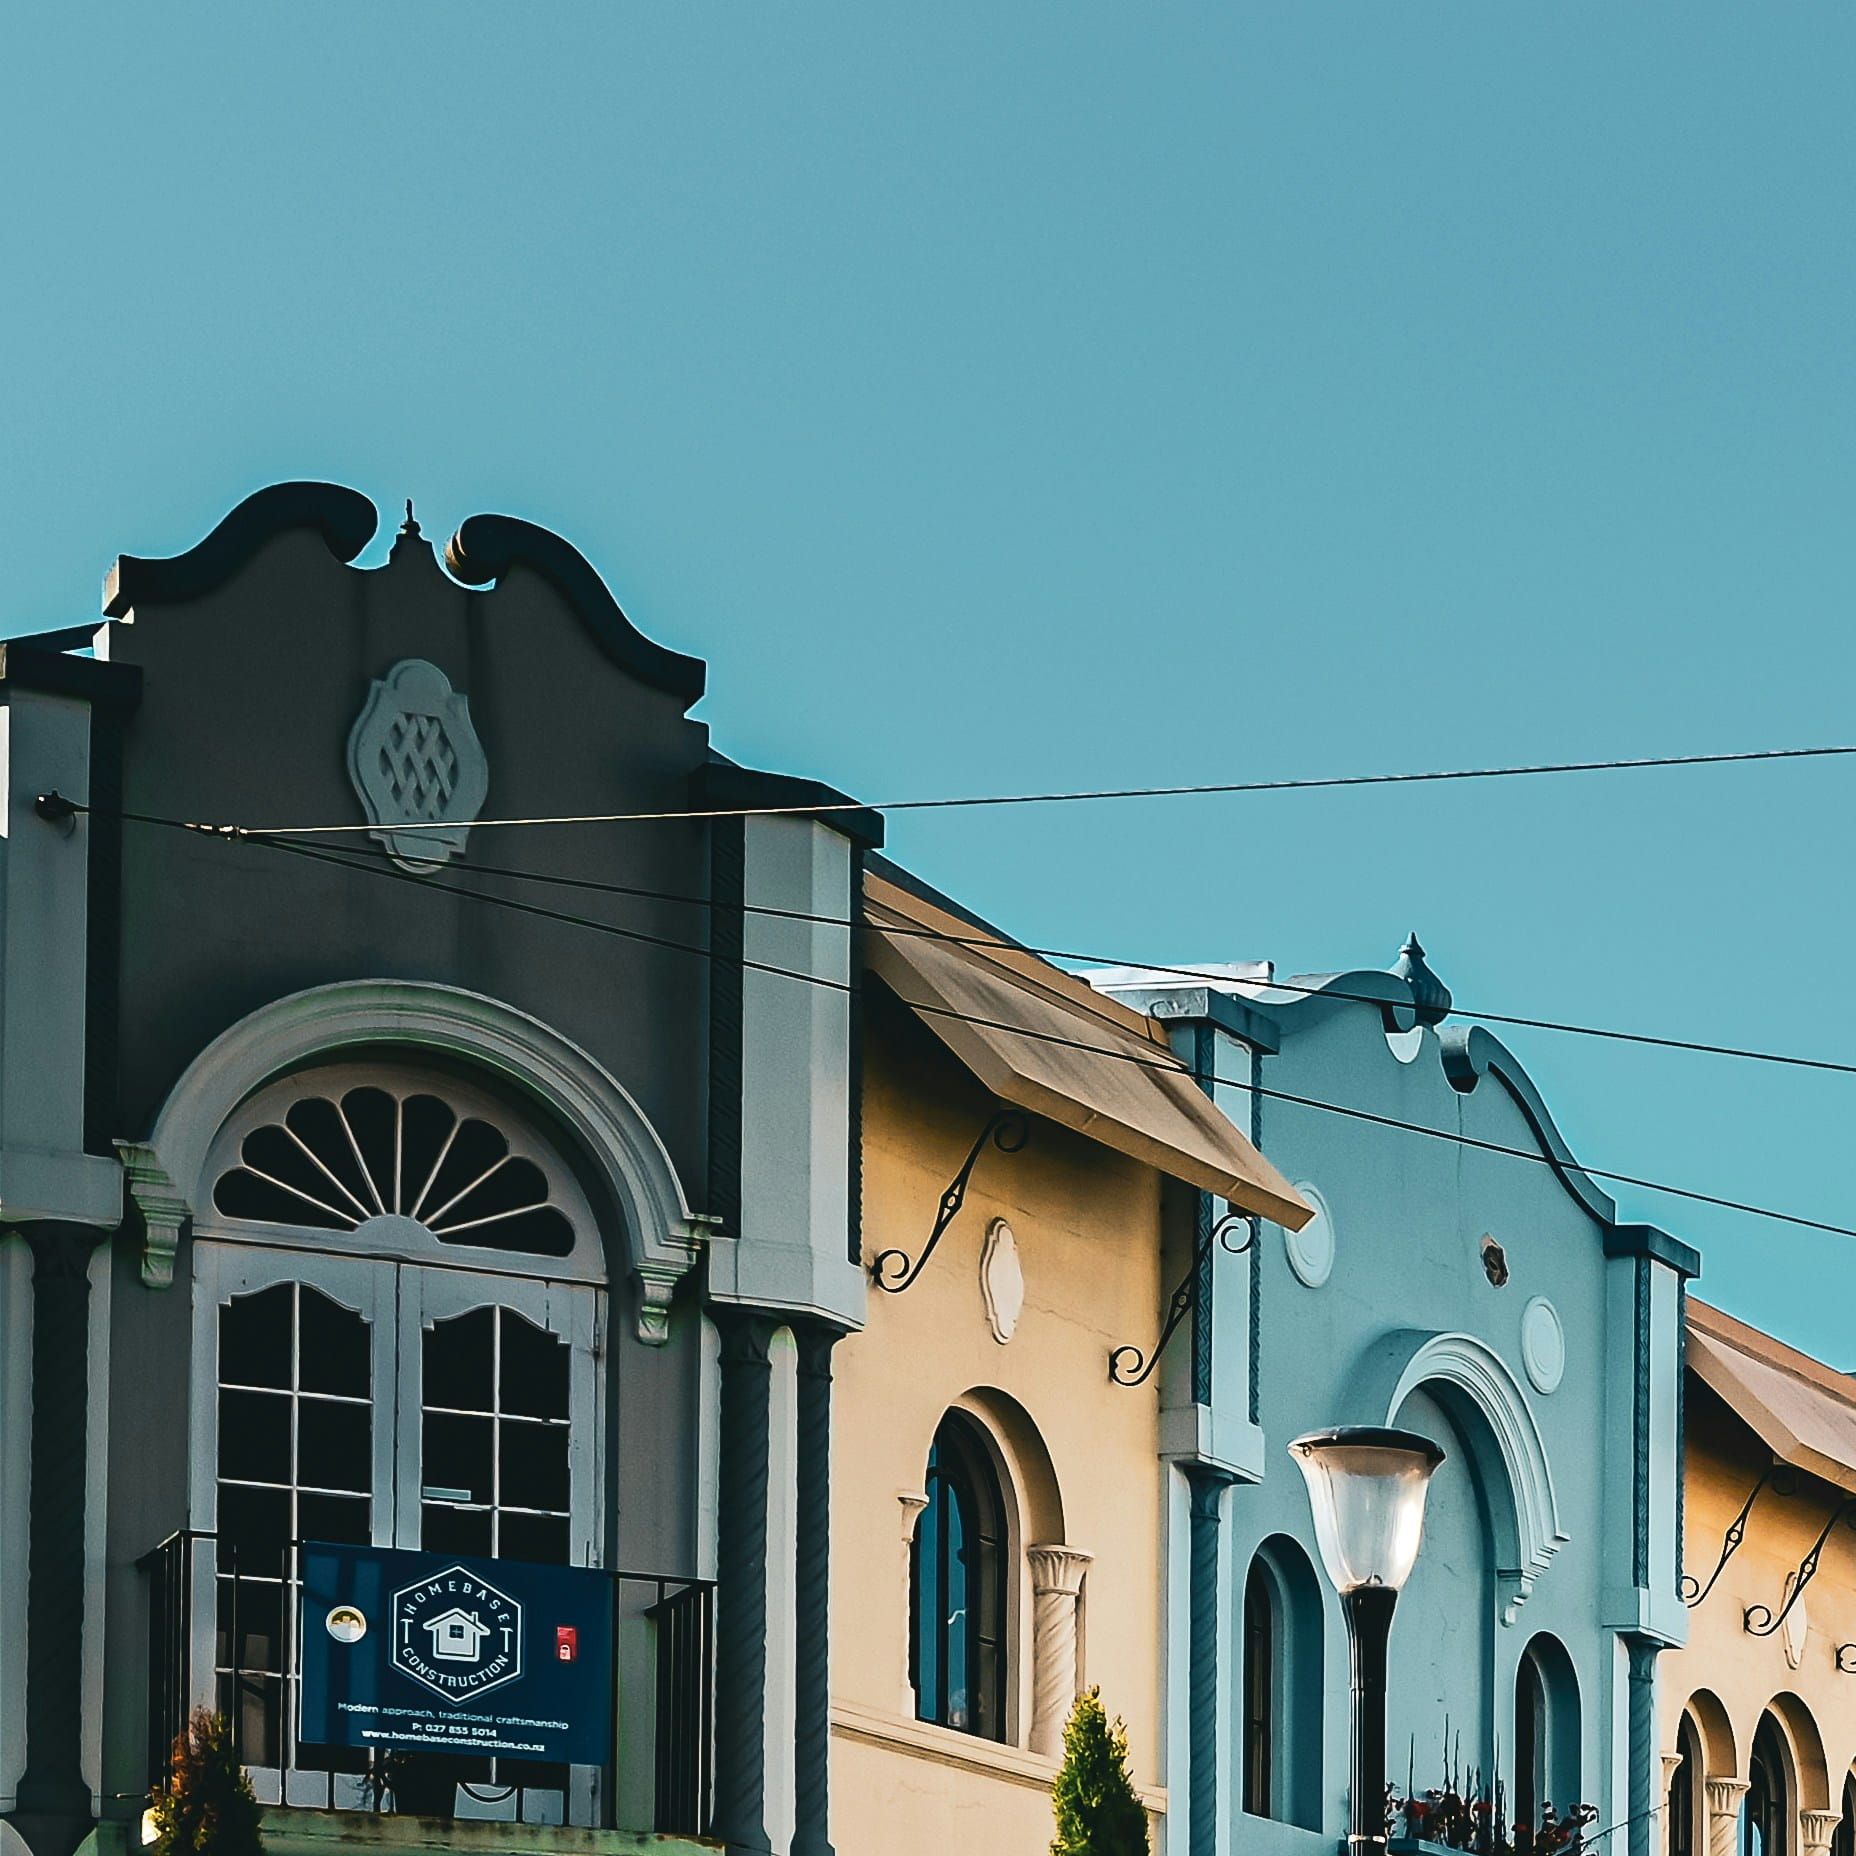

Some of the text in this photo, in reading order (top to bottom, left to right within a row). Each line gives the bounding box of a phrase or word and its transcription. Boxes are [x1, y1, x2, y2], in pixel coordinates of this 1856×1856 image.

[403, 1581, 511, 1622] HOMEBASE
[402, 1647, 510, 1687] CONSTRUCTION
[337, 1702, 569, 1730] Modern approach, traditional craftsmanship
